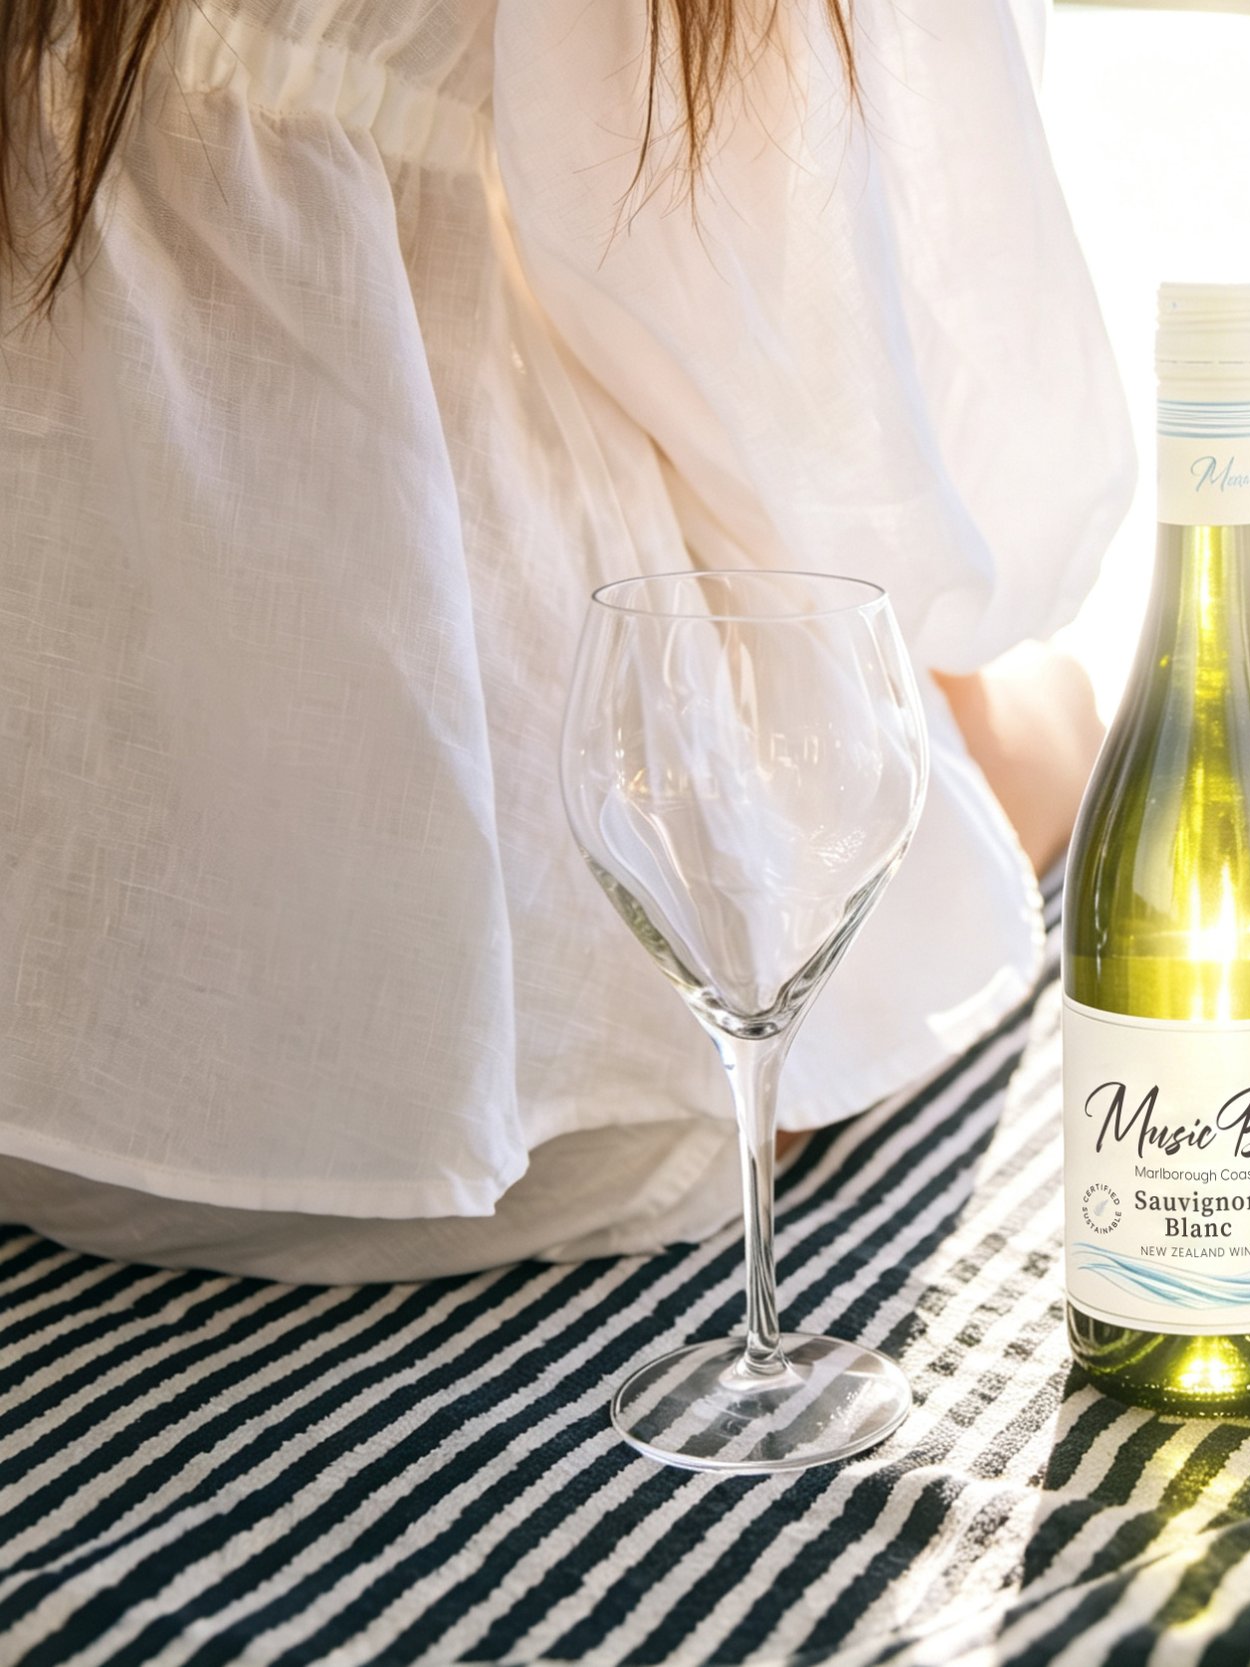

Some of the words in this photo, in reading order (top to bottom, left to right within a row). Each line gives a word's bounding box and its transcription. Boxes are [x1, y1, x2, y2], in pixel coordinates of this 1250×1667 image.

[1084, 1081, 1218, 1159] Music
[1134, 1165, 1217, 1185] Marlborough
[1082, 1183, 1121, 1206] CERTIFIED
[1082, 1206, 1122, 1235] SUSTAINABLE
[1165, 1217, 1232, 1238] Blanc
[1140, 1246, 1167, 1257] NEW
[1171, 1247, 1225, 1258] ZEALAND
